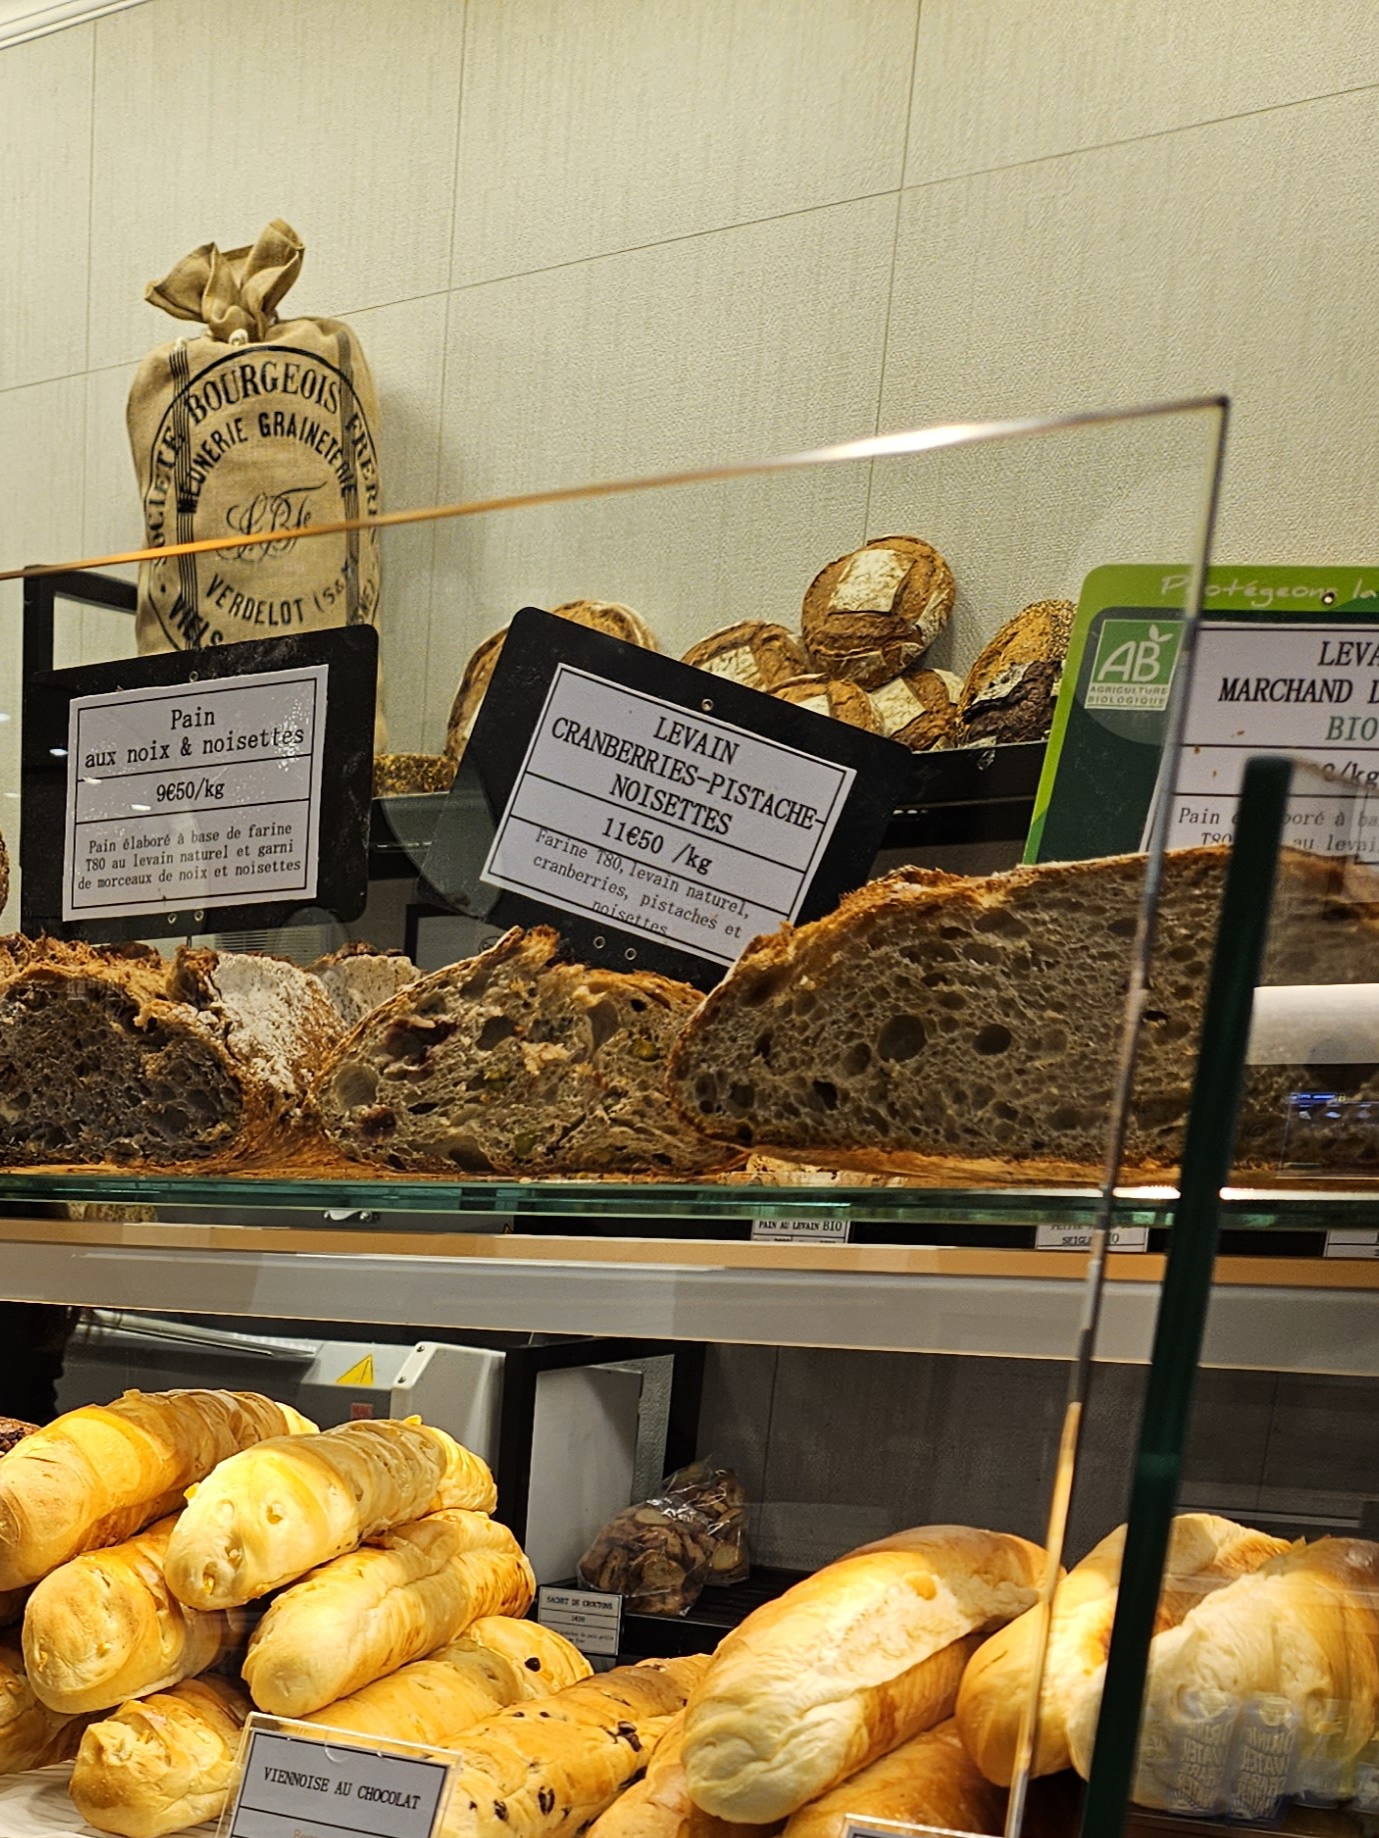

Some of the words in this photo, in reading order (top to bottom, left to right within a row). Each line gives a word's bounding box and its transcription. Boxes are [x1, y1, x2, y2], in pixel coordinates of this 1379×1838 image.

[184, 361, 340, 425] BOURGEOIS
[206, 573, 304, 626] VERDELOT
[1161, 574, 1338, 608] Potégeons
[1098, 640, 1161, 681] AB
[1218, 677, 1353, 704] MARCHAND
[171, 707, 215, 730] Pain
[1325, 715, 1379, 741] BIO
[85, 749, 116, 768] aux
[127, 741, 171, 764] noix
[180, 736, 192, 757] &
[202, 728, 305, 756] noisettes
[652, 716, 740, 766] LEVAIN
[156, 778, 225, 803] 9€50/kg
[551, 716, 825, 831] CRANBERRIES-PISTACHE-
[609, 773, 733, 836] NOISETTES
[1178, 807, 1220, 825] Pain
[86, 857, 106, 872] T80
[112, 858, 126, 870] au
[133, 850, 174, 868] levain
[180, 844, 228, 864] naturel
[236, 845, 251, 858] et
[258, 838, 294, 858] garni
[89, 838, 116, 854] Pain
[123, 834, 171, 852] élaboré
[177, 832, 185, 846] à
[191, 827, 220, 844] base
[226, 825, 241, 840] de
[249, 821, 292, 839] farine
[601, 816, 665, 855] 11€50
[672, 842, 713, 877] /kg
[78, 875, 92, 890] de
[97, 871, 152, 888] morceaux
[158, 868, 173, 883] de
[178, 865, 208, 881] noix
[214, 863, 228, 877] et
[235, 858, 301, 877] noisettes
[535, 829, 589, 860] Farine
[629, 863, 680, 893] levain
[686, 880, 750, 919] naturel,
[533, 853, 629, 900] cranberries,
[639, 892, 719, 931] pistaches
[725, 921, 742, 939] et
[758, 1220, 777, 1229] PAIN
[792, 1221, 820, 1230] LEVAIN
[823, 1220, 843, 1231] BIO
[264, 1766, 330, 1792] VIENNOISE
[334, 1783, 352, 1796] AU
[357, 1785, 420, 1810] CHOCOLAT
